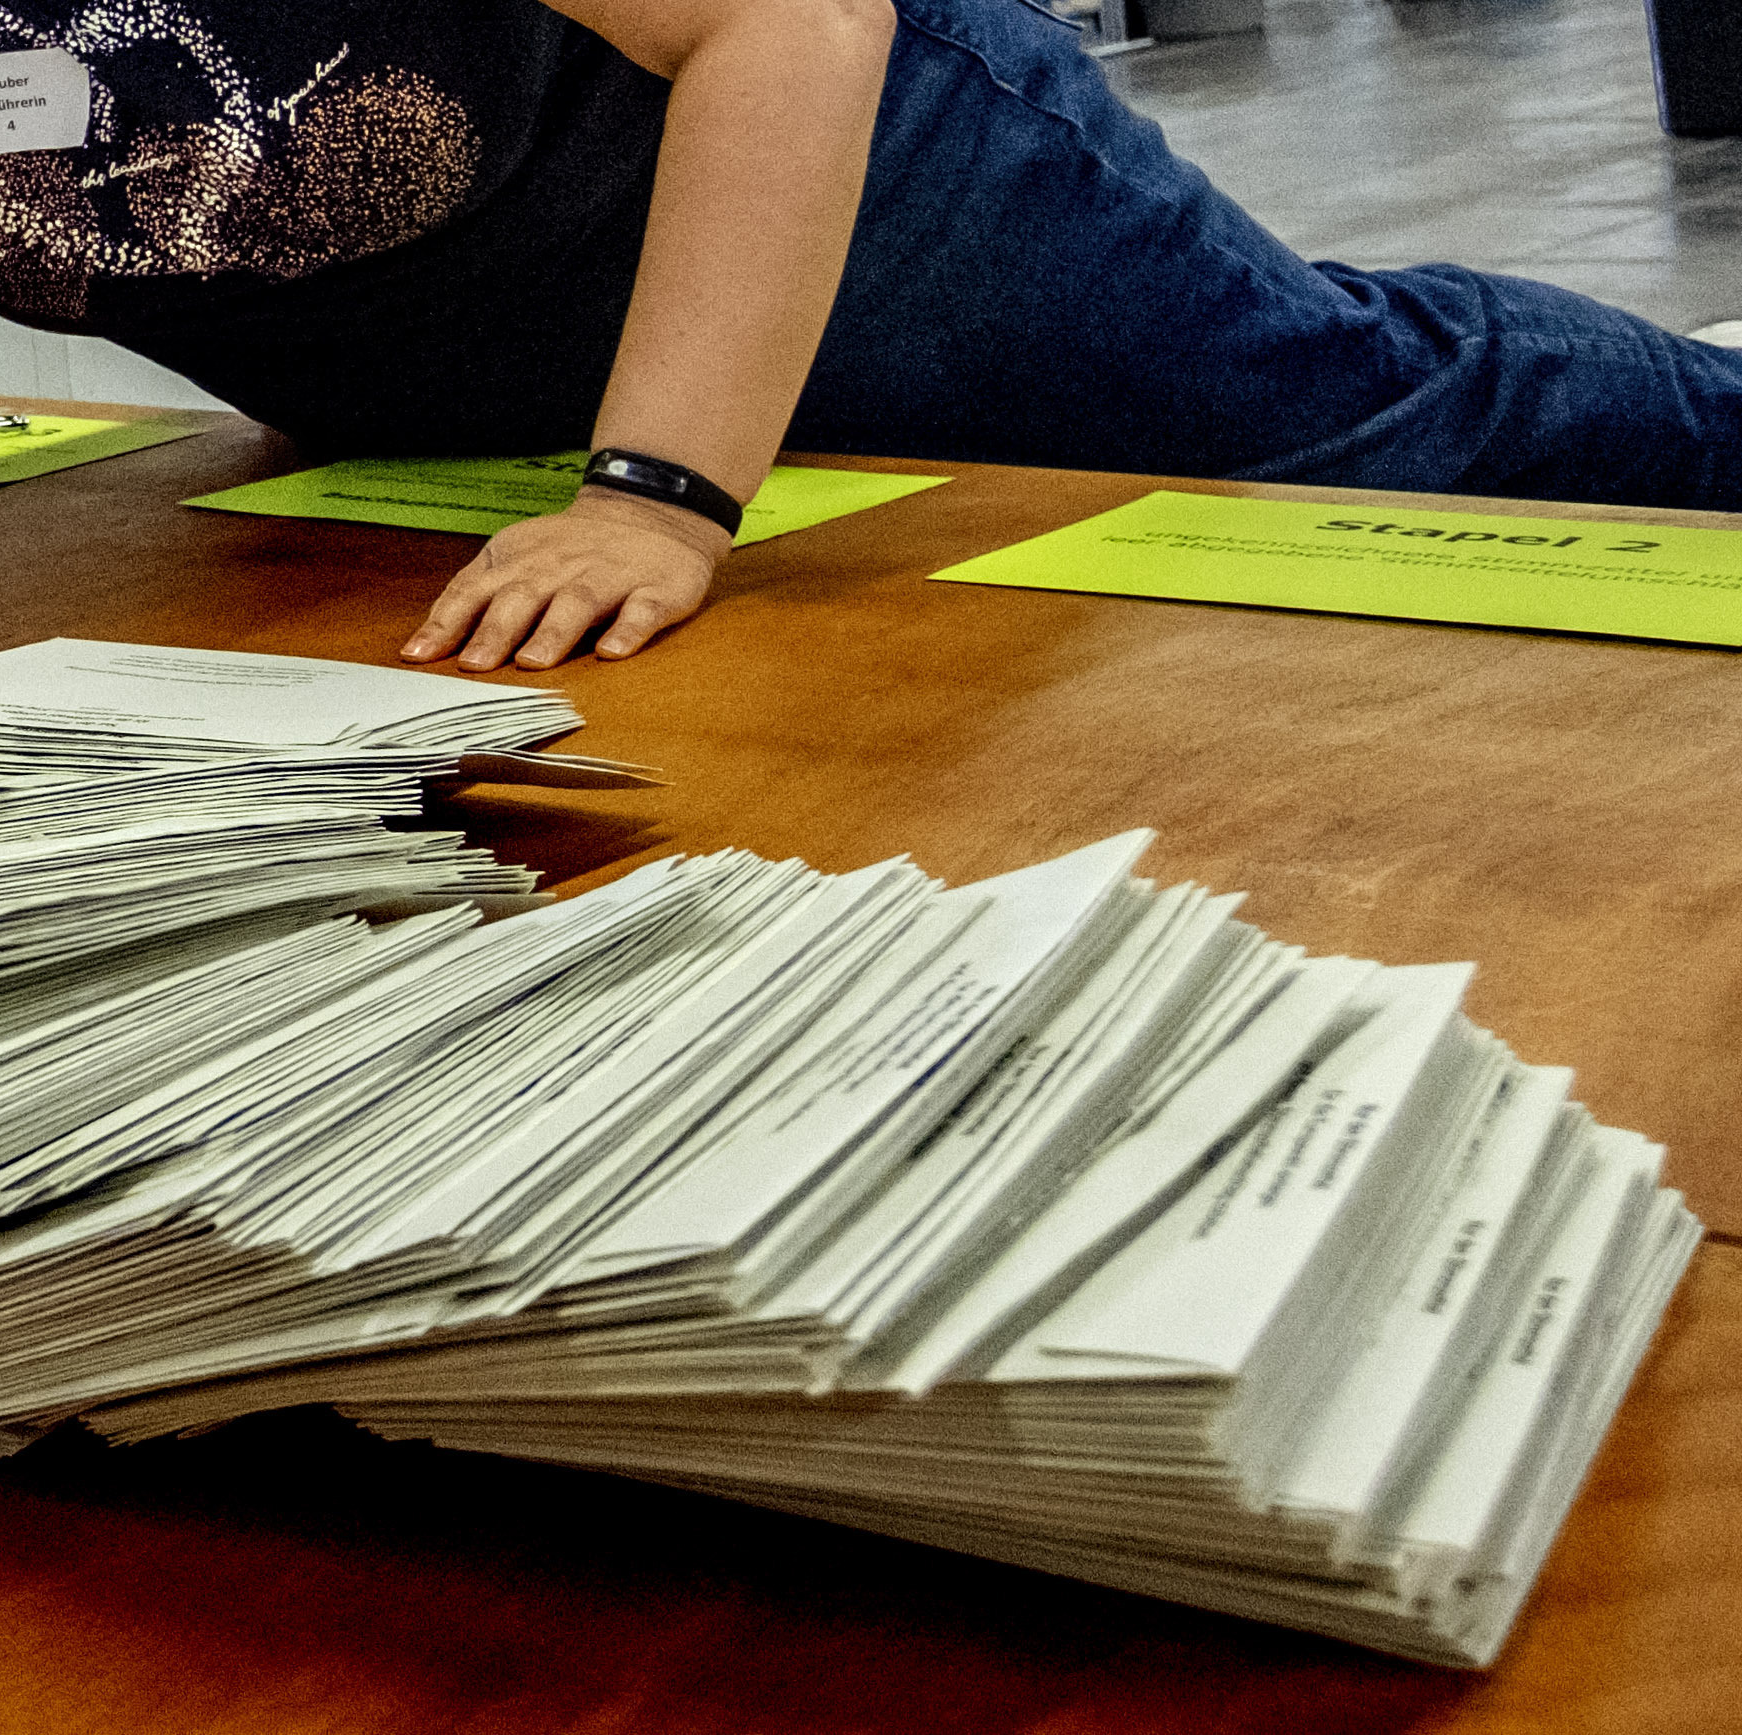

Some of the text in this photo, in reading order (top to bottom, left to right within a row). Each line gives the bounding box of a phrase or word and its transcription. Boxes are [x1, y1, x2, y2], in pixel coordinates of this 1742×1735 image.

[7, 119, 16, 131] 4
[1314, 519, 1662, 554] Stapel 2
